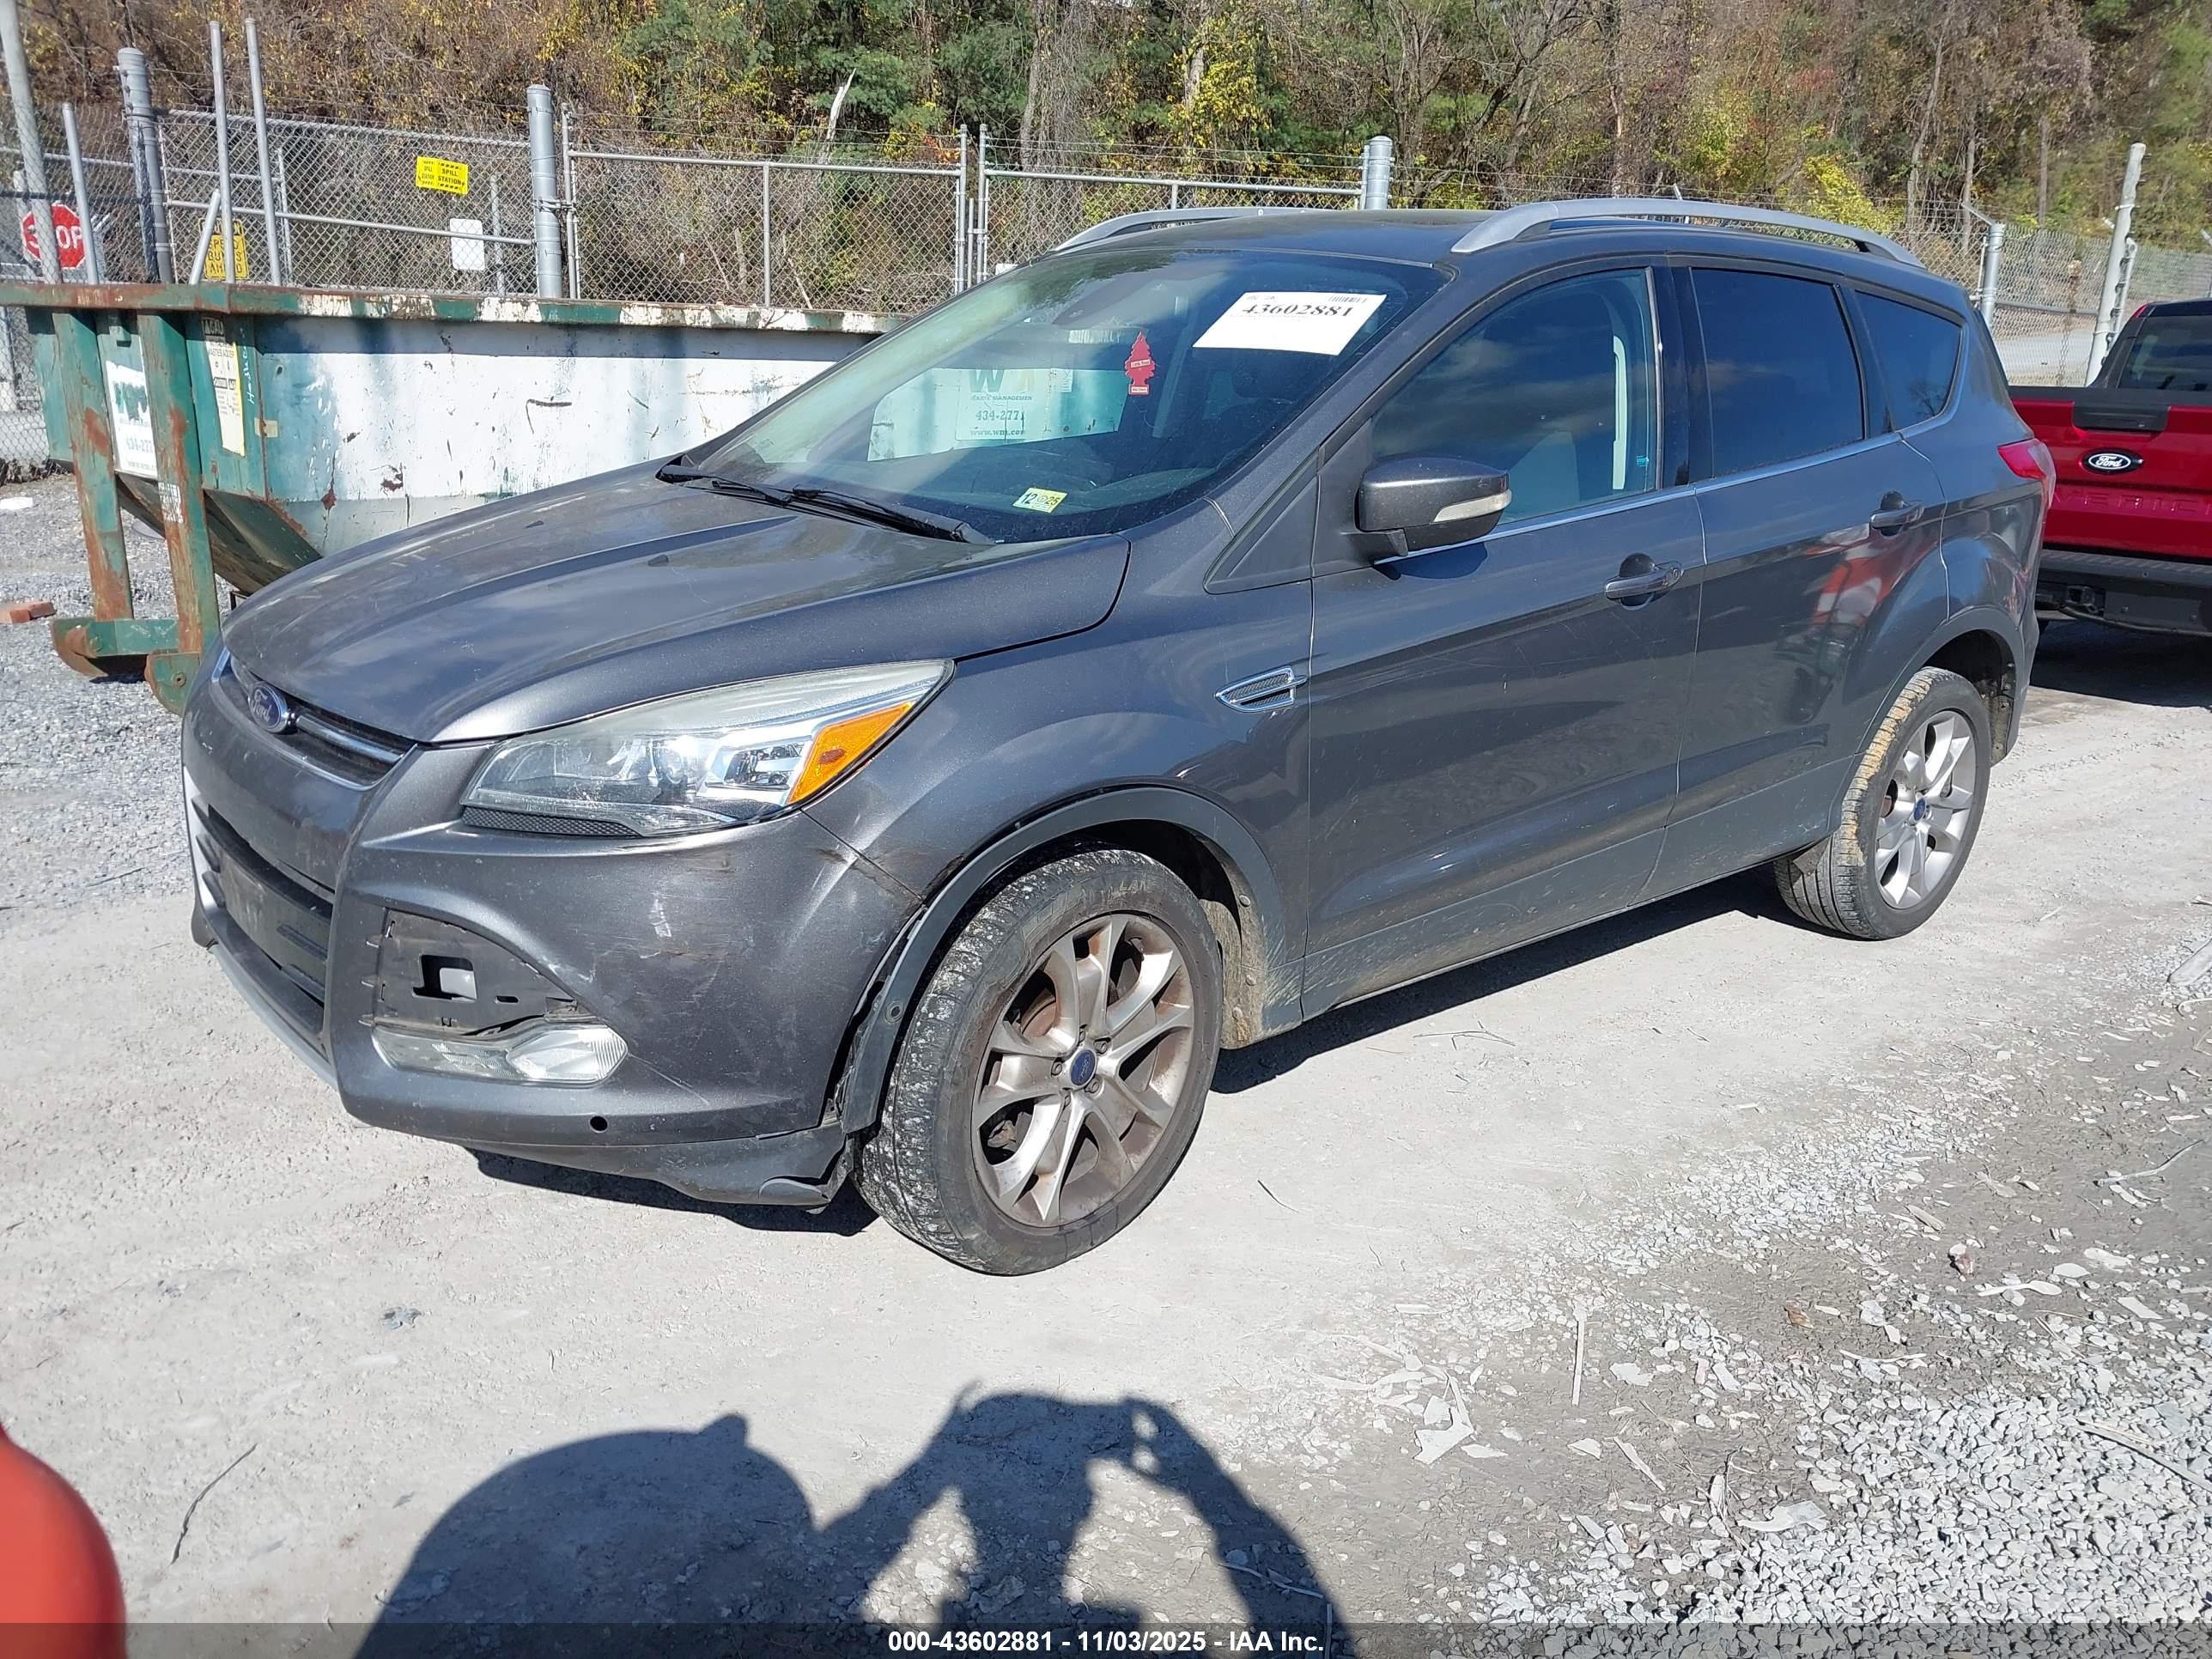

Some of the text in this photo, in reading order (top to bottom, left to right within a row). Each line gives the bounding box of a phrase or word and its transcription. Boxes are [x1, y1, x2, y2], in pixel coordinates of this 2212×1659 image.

[441, 167, 459, 177] SPILL
[438, 175, 462, 185] STATION
[27, 224, 82, 249] SOP
[208, 250, 242, 262] BUS
[210, 263, 242, 274] AHD
[1243, 304, 1353, 317] 43602881
[2095, 455, 2124, 467] Ford
[1020, 493, 1060, 506] 12 25
[251, 689, 272, 722] Ford
